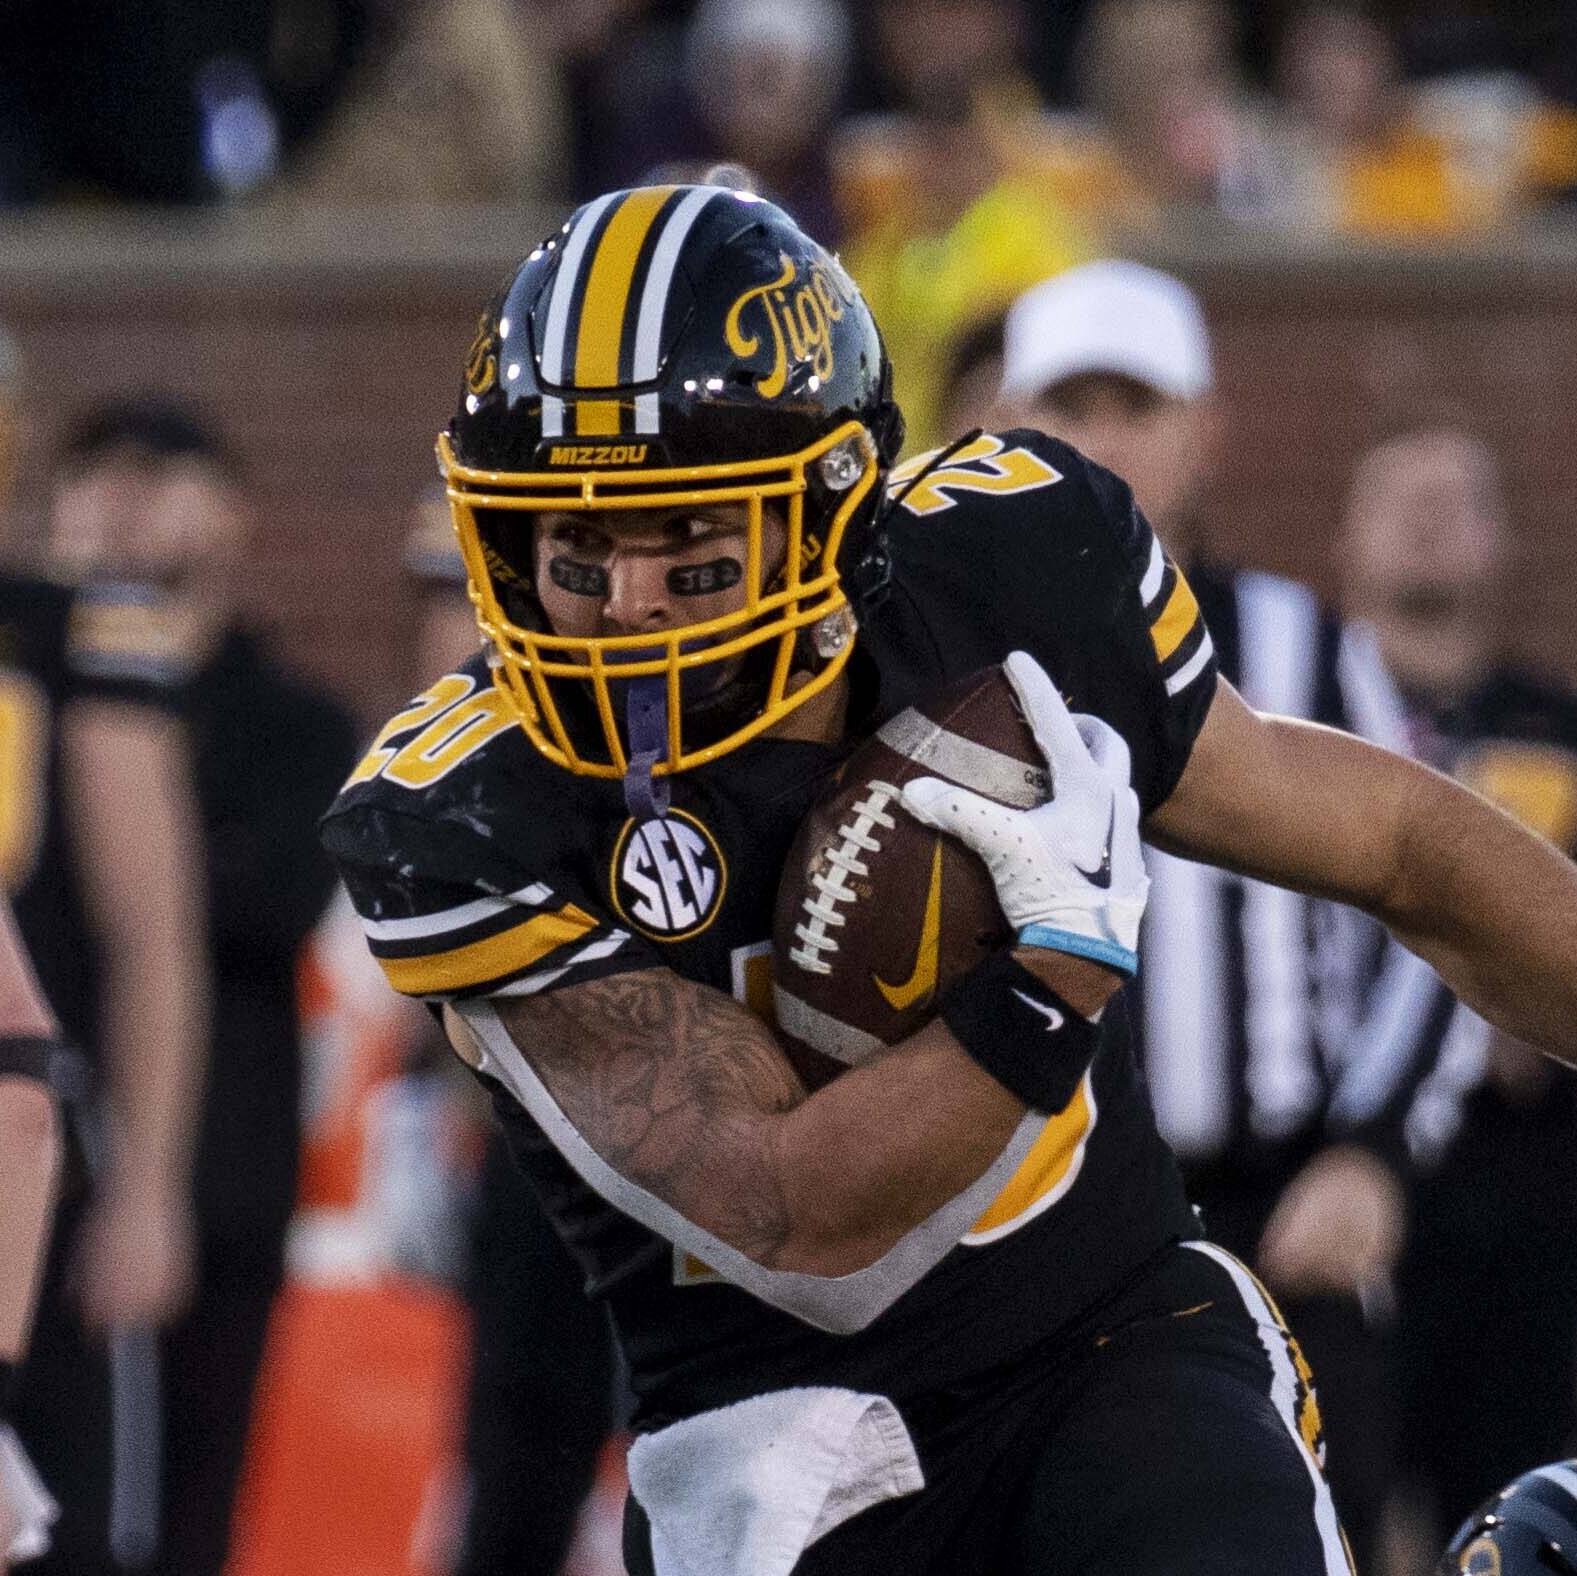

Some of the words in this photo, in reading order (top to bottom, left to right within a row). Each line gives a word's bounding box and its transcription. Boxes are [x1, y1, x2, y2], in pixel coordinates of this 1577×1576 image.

[550, 444, 648, 465] MIZZOU
[339, 674, 522, 790] 20
[622, 818, 716, 931] SEC
